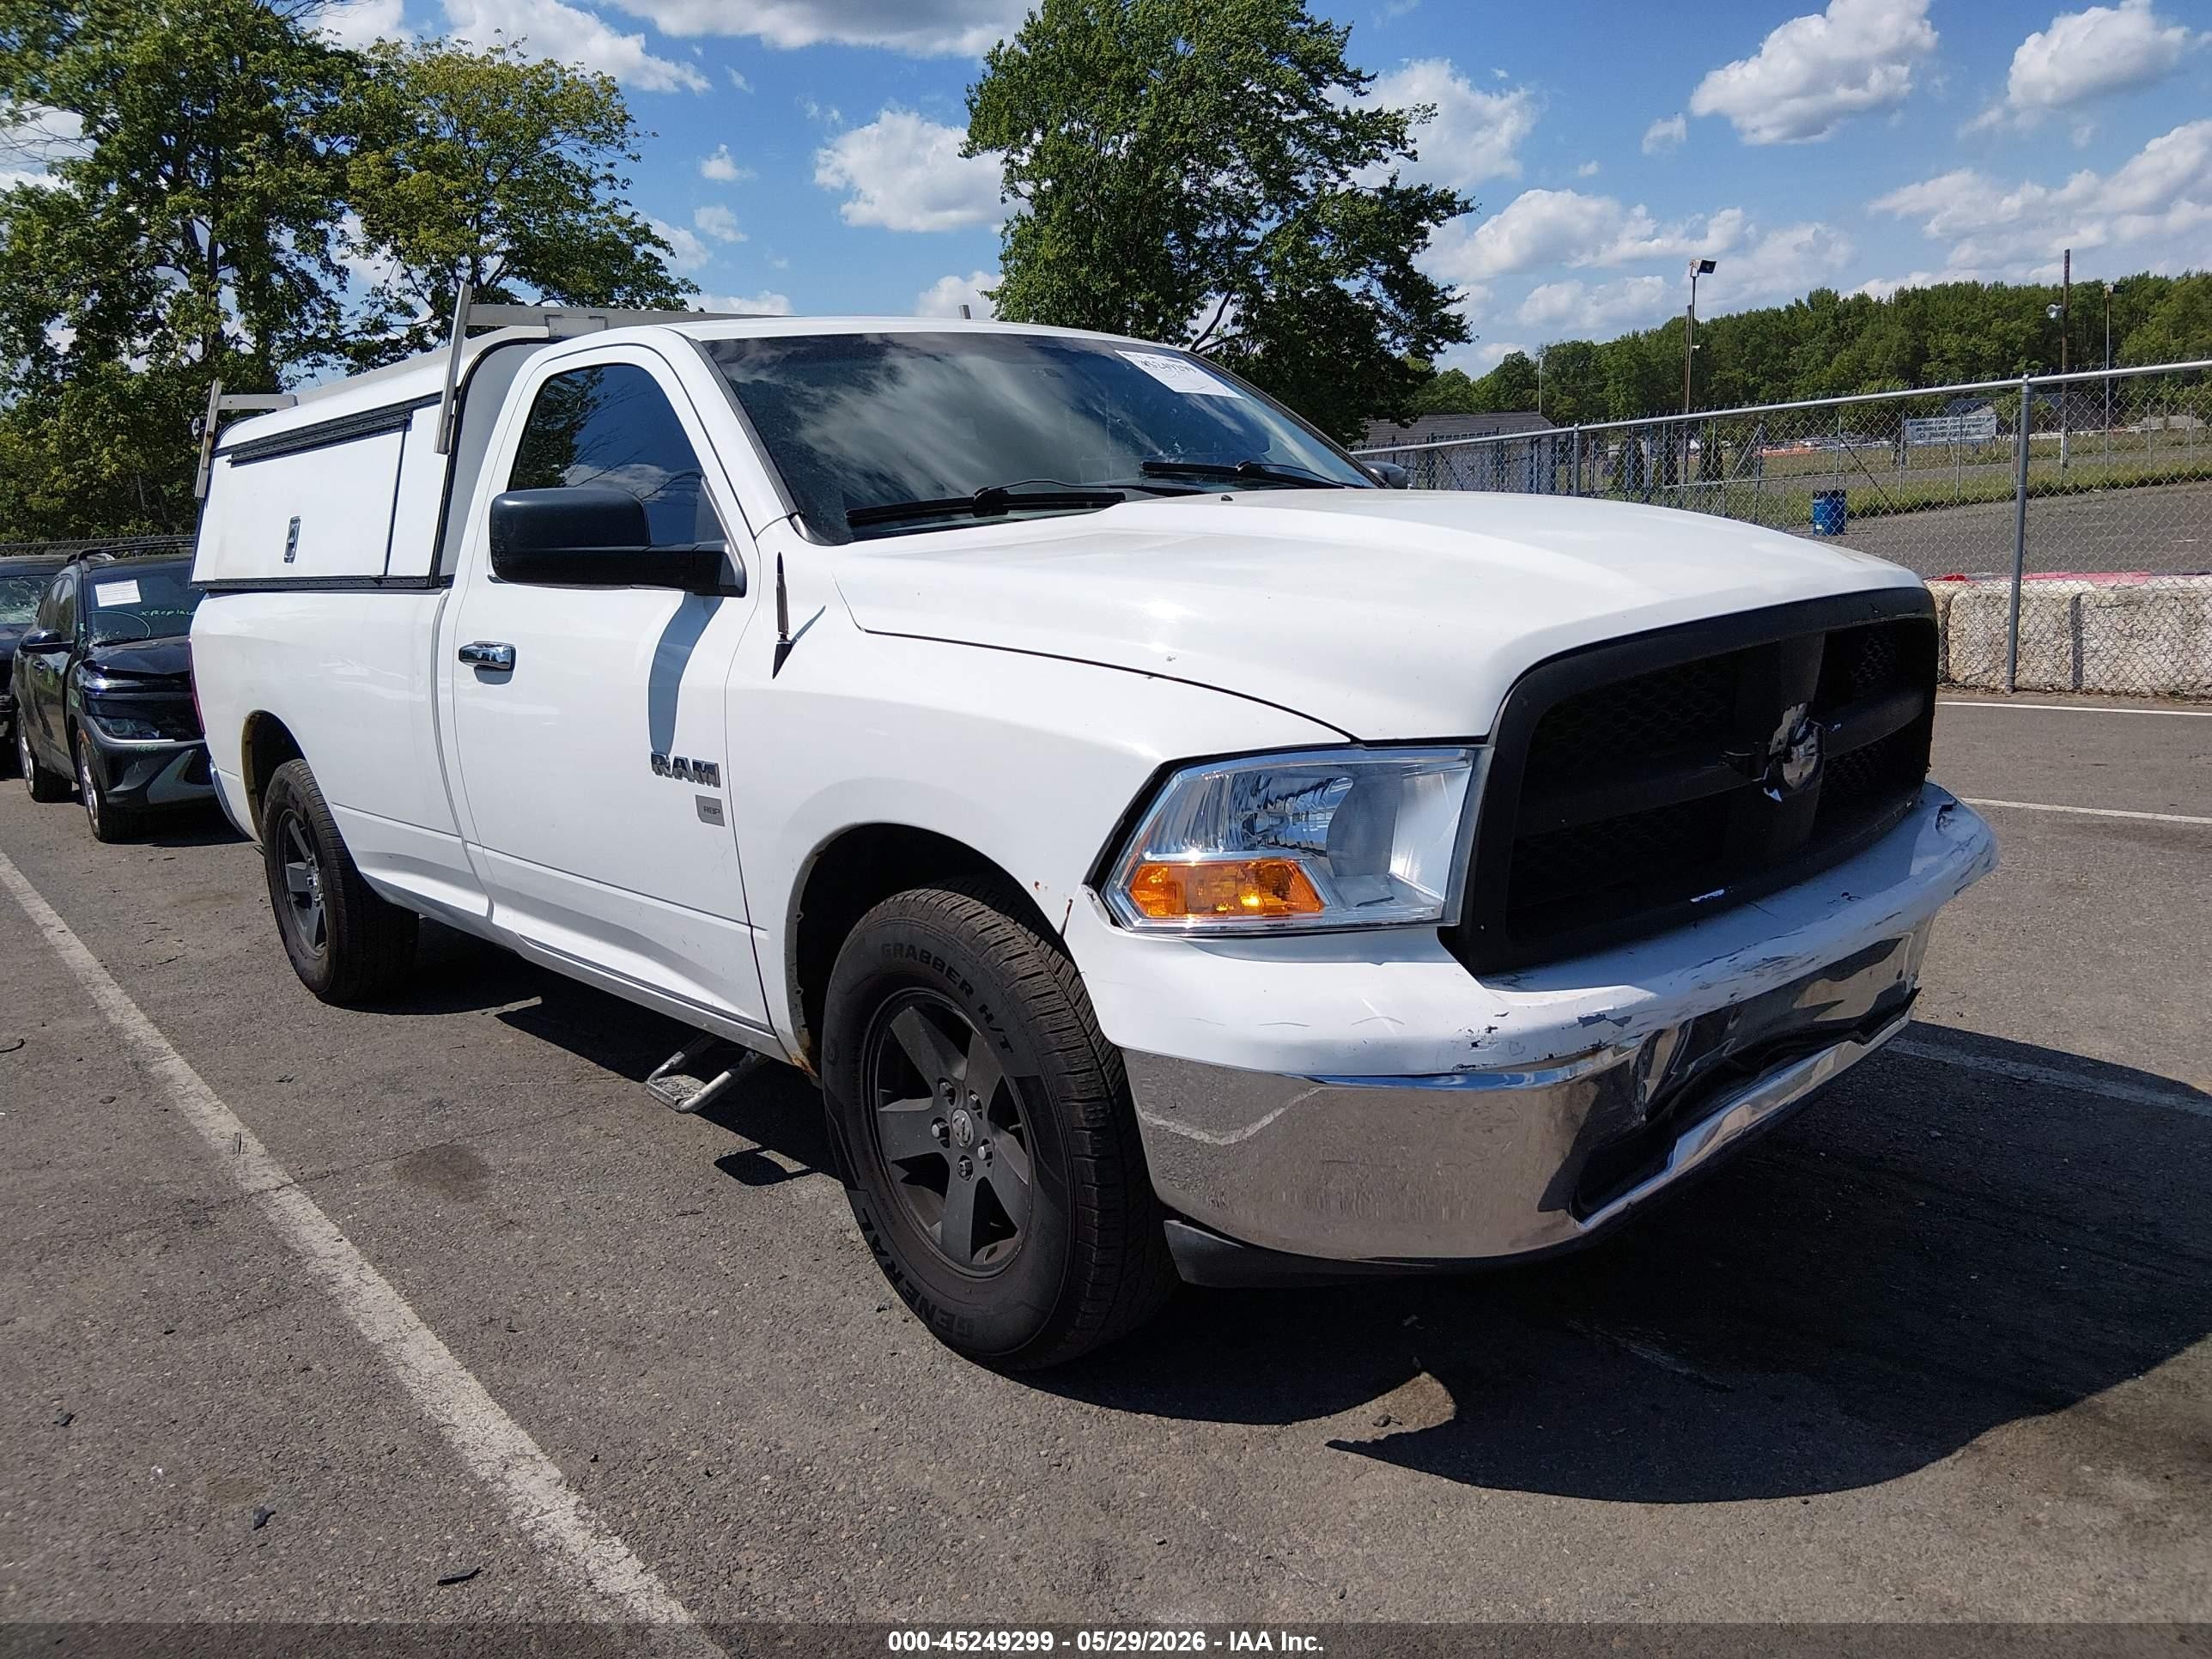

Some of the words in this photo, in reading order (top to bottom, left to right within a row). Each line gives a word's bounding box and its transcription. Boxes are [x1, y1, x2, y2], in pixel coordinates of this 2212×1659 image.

[651, 752, 721, 787] RAM
[881, 943, 975, 998] GRABBER
[976, 1003, 1014, 1054] H/T
[859, 1207, 975, 1340] GENERAL
